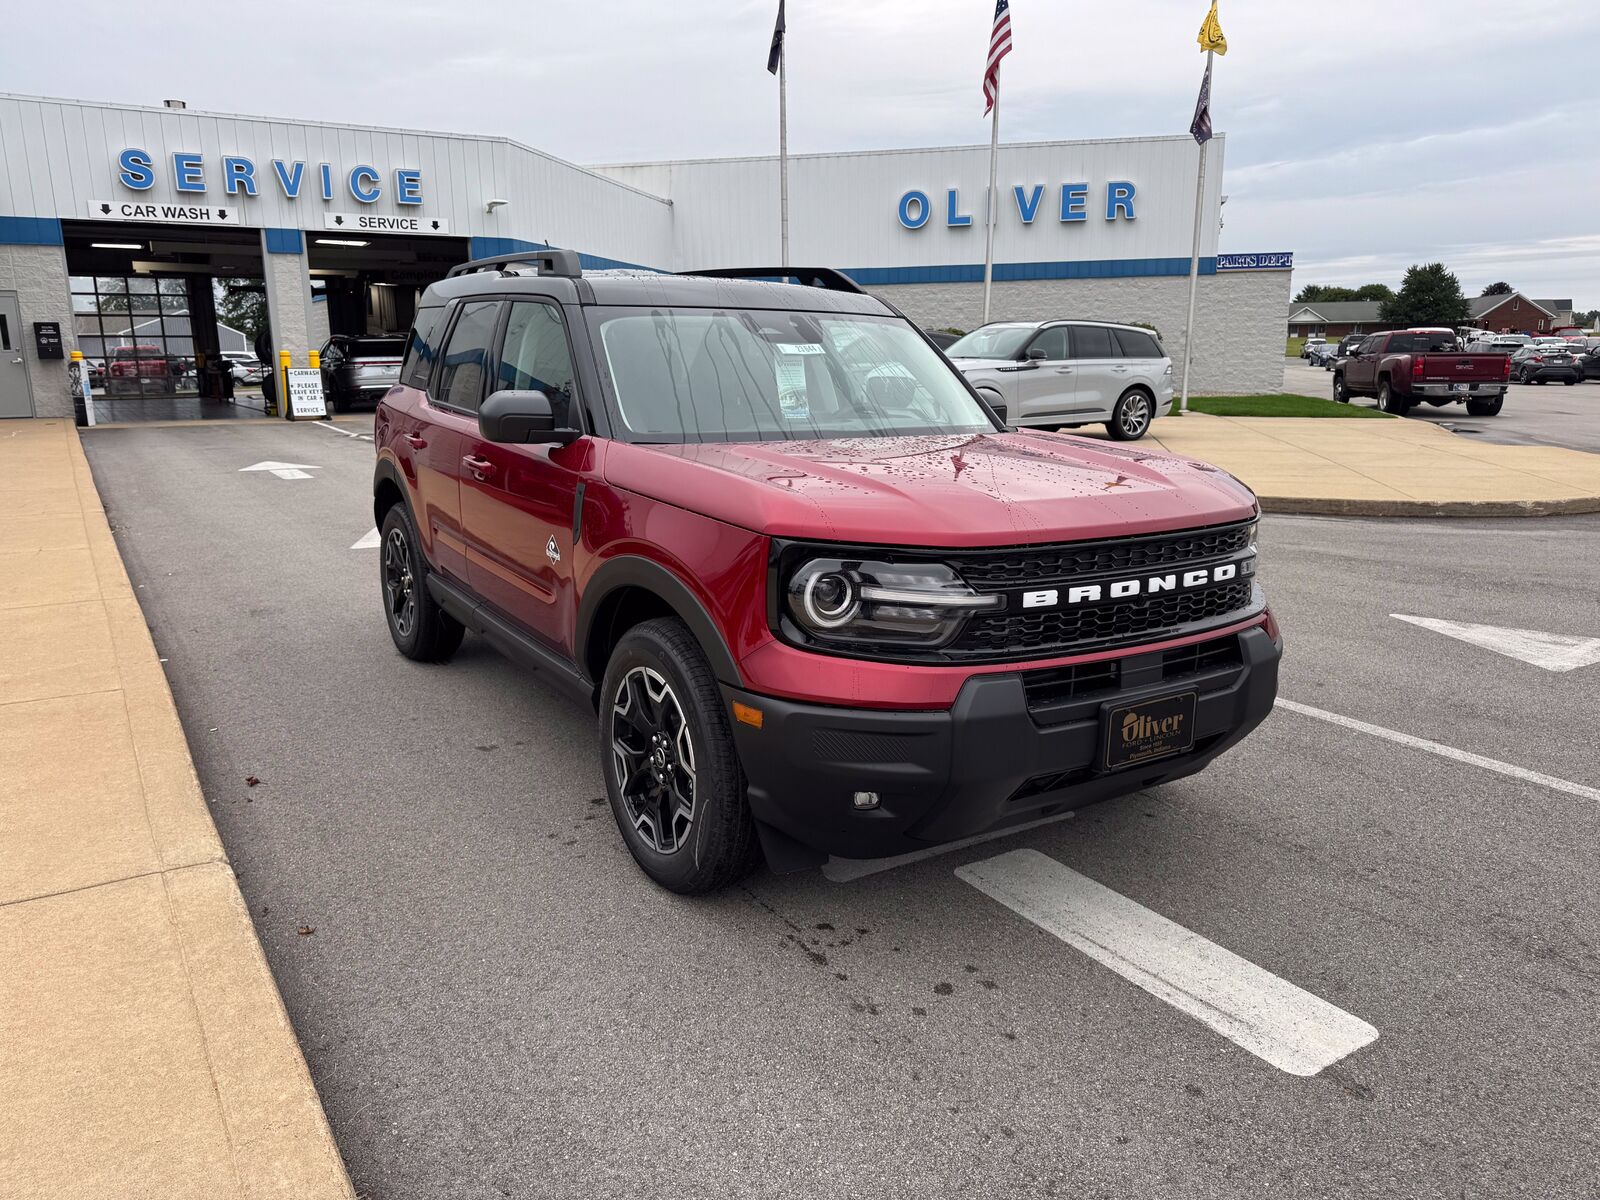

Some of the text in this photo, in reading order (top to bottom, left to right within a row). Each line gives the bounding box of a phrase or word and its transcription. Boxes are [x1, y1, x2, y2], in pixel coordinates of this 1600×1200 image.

[118, 148, 424, 205] SERVICE
[121, 204, 211, 220] CAR WASH
[358, 216, 419, 231] SERVICE
[1217, 255, 1257, 268] PARTS
[1022, 564, 1237, 609] BRONCO
[1121, 712, 1184, 742] Oliver
